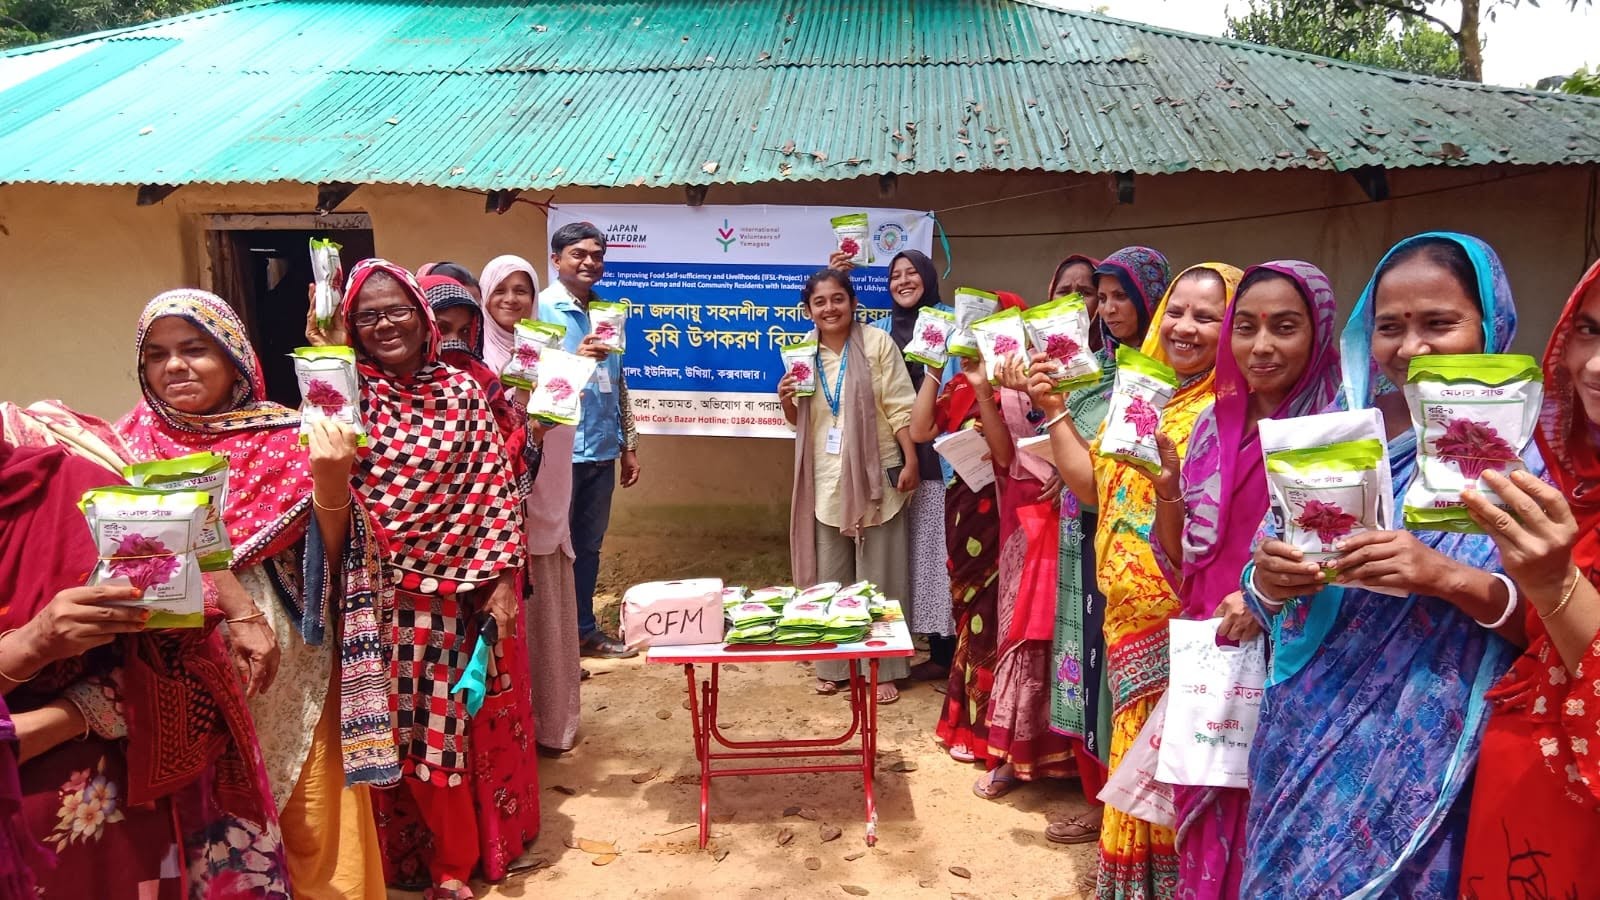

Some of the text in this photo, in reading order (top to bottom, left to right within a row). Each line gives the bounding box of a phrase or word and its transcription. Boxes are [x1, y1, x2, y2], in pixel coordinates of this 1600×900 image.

[607, 224, 638, 232] JAPAN
[619, 298, 645, 319] ীন
[648, 303, 702, 324] জলবায়ু
[705, 300, 770, 322] সহনশীল
[854, 302, 892, 322] বিষয়
[642, 323, 808, 357] কৃষি উপকরণ বিত
[700, 397, 741, 410] অভিযোগ
[744, 400, 754, 410] বা
[644, 607, 703, 635] CFM
